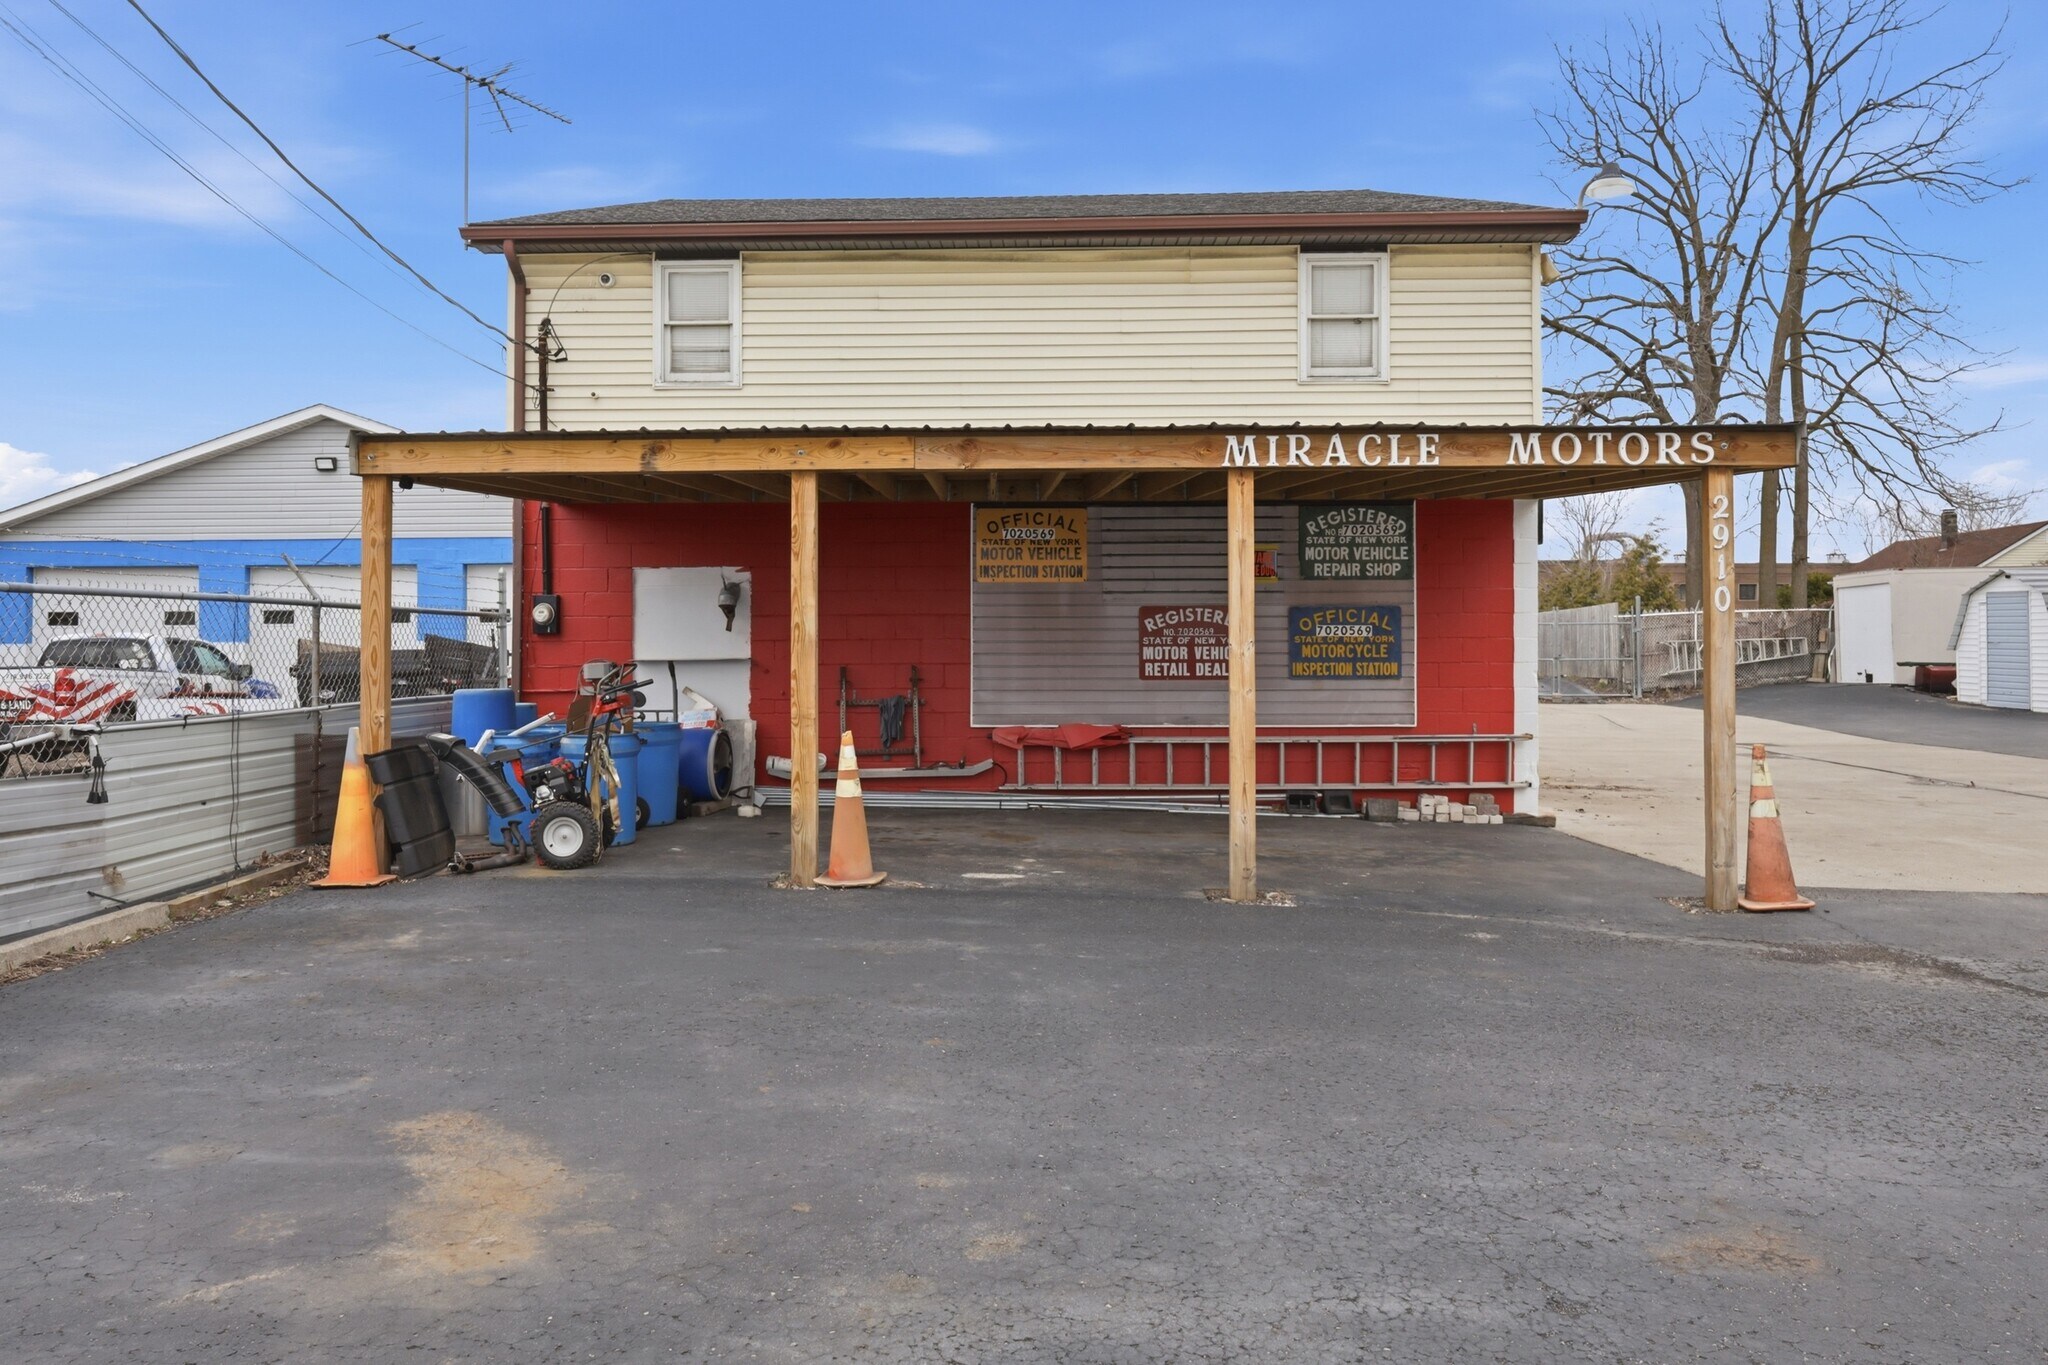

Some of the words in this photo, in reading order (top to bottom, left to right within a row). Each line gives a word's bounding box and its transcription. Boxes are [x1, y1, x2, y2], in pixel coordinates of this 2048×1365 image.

[1221, 433, 1440, 467] MIRACLE
[1506, 432, 1715, 465] MOTORS
[986, 512, 1078, 534] OFFICIAL
[1306, 507, 1407, 535] REGISTERED
[1003, 528, 1055, 539] 7020569
[1343, 525, 1398, 535] 7020569
[981, 538, 1010, 546] STATE
[1055, 538, 1081, 546] YORK
[1306, 536, 1336, 544] STATE
[1339, 536, 1352, 544] OF
[1355, 536, 1376, 544] NEW
[1380, 536, 1407, 544] YORK
[981, 547, 1023, 560] MOTOR
[1027, 547, 1082, 560] VEHICLE
[1305, 547, 1350, 560] MOTOR
[1353, 546, 1409, 560] VEHICLE
[1712, 494, 1731, 613] 2910
[979, 565, 1039, 578] INSPECTION
[1042, 565, 1083, 578] STATION
[1314, 563, 1361, 577] REPAIR
[1366, 563, 1401, 577] SHOP
[1299, 609, 1392, 631] OFFICIAL
[1178, 628, 1214, 636] 7020569
[1317, 626, 1372, 636] 7020569
[1142, 637, 1173, 645] STATE
[1177, 637, 1190, 645] OF
[1194, 637, 1216, 645] NEW
[1294, 635, 1324, 643] STATE
[1369, 635, 1395, 643] YORK
[1142, 646, 1188, 660] MOTOR
[1301, 644, 1388, 658] MOTORCYCLE
[1145, 663, 1190, 676] RETAIL
[1292, 662, 1353, 676] INSPECTION
[1356, 662, 1398, 676] STATION
[8, 699, 32, 710] LAND
